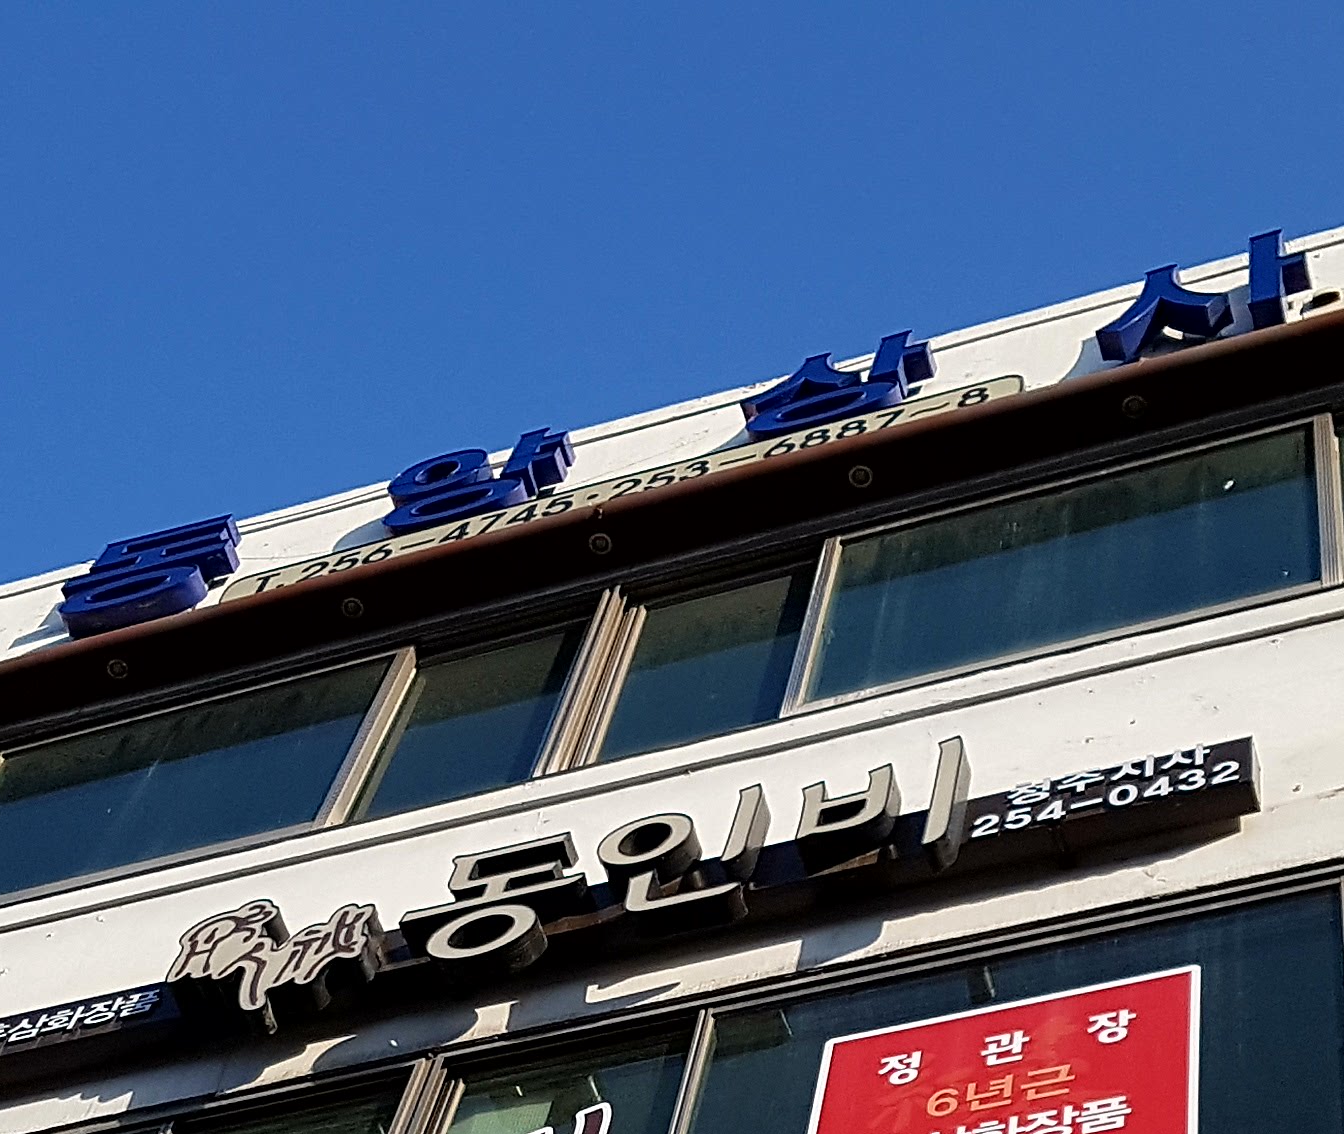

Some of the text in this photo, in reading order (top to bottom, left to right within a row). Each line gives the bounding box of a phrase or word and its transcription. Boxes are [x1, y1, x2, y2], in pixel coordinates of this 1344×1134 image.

[58, 228, 1311, 635] 동양상사
[970, 760, 1240, 839] 254-0432
[1007, 744, 1211, 805] 청주지사
[400, 735, 969, 970] 동인비
[925, 1062, 1076, 1118] 6년근
